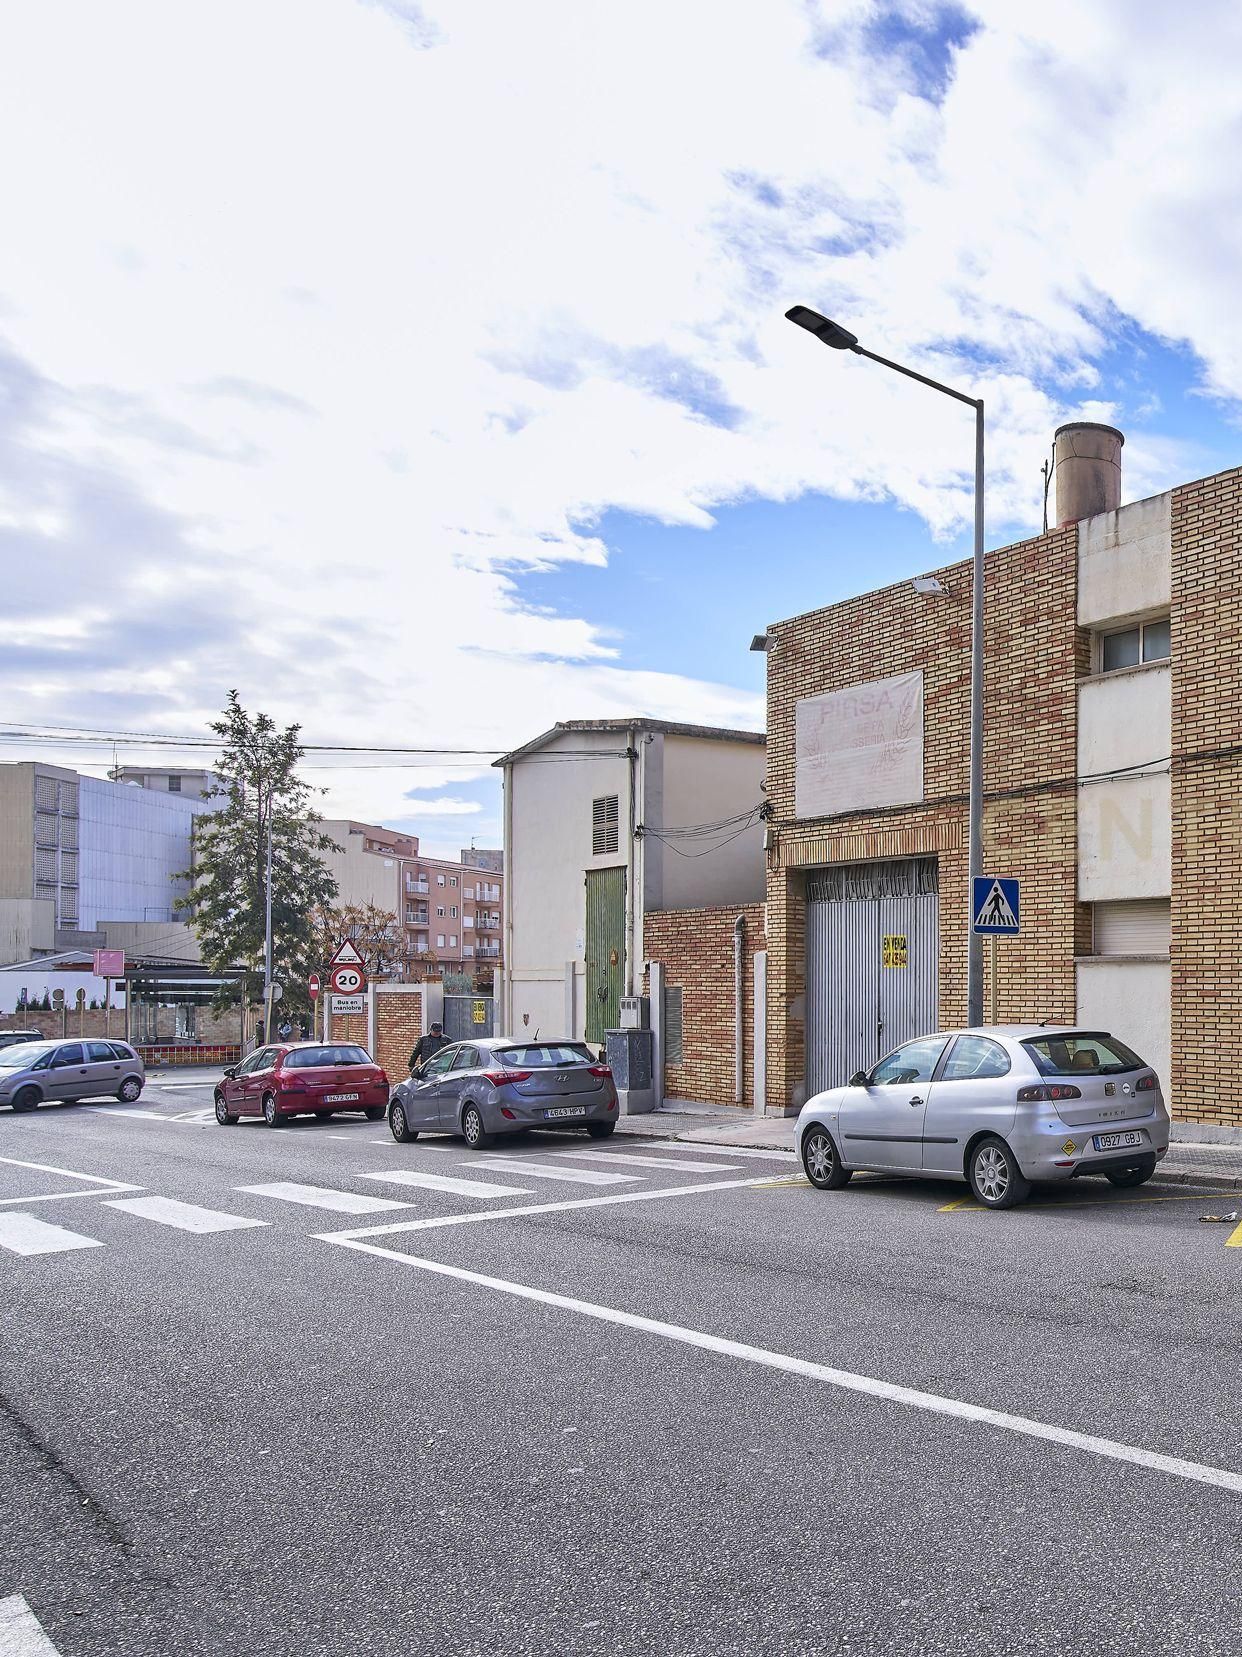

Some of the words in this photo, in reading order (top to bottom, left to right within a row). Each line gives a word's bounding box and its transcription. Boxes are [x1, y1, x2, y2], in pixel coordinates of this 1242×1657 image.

[820, 689, 895, 725] PIRSA
[338, 975, 358, 986] 20
[1100, 1134, 1121, 1147] 0927
[1124, 1133, 1141, 1144] GBJ
